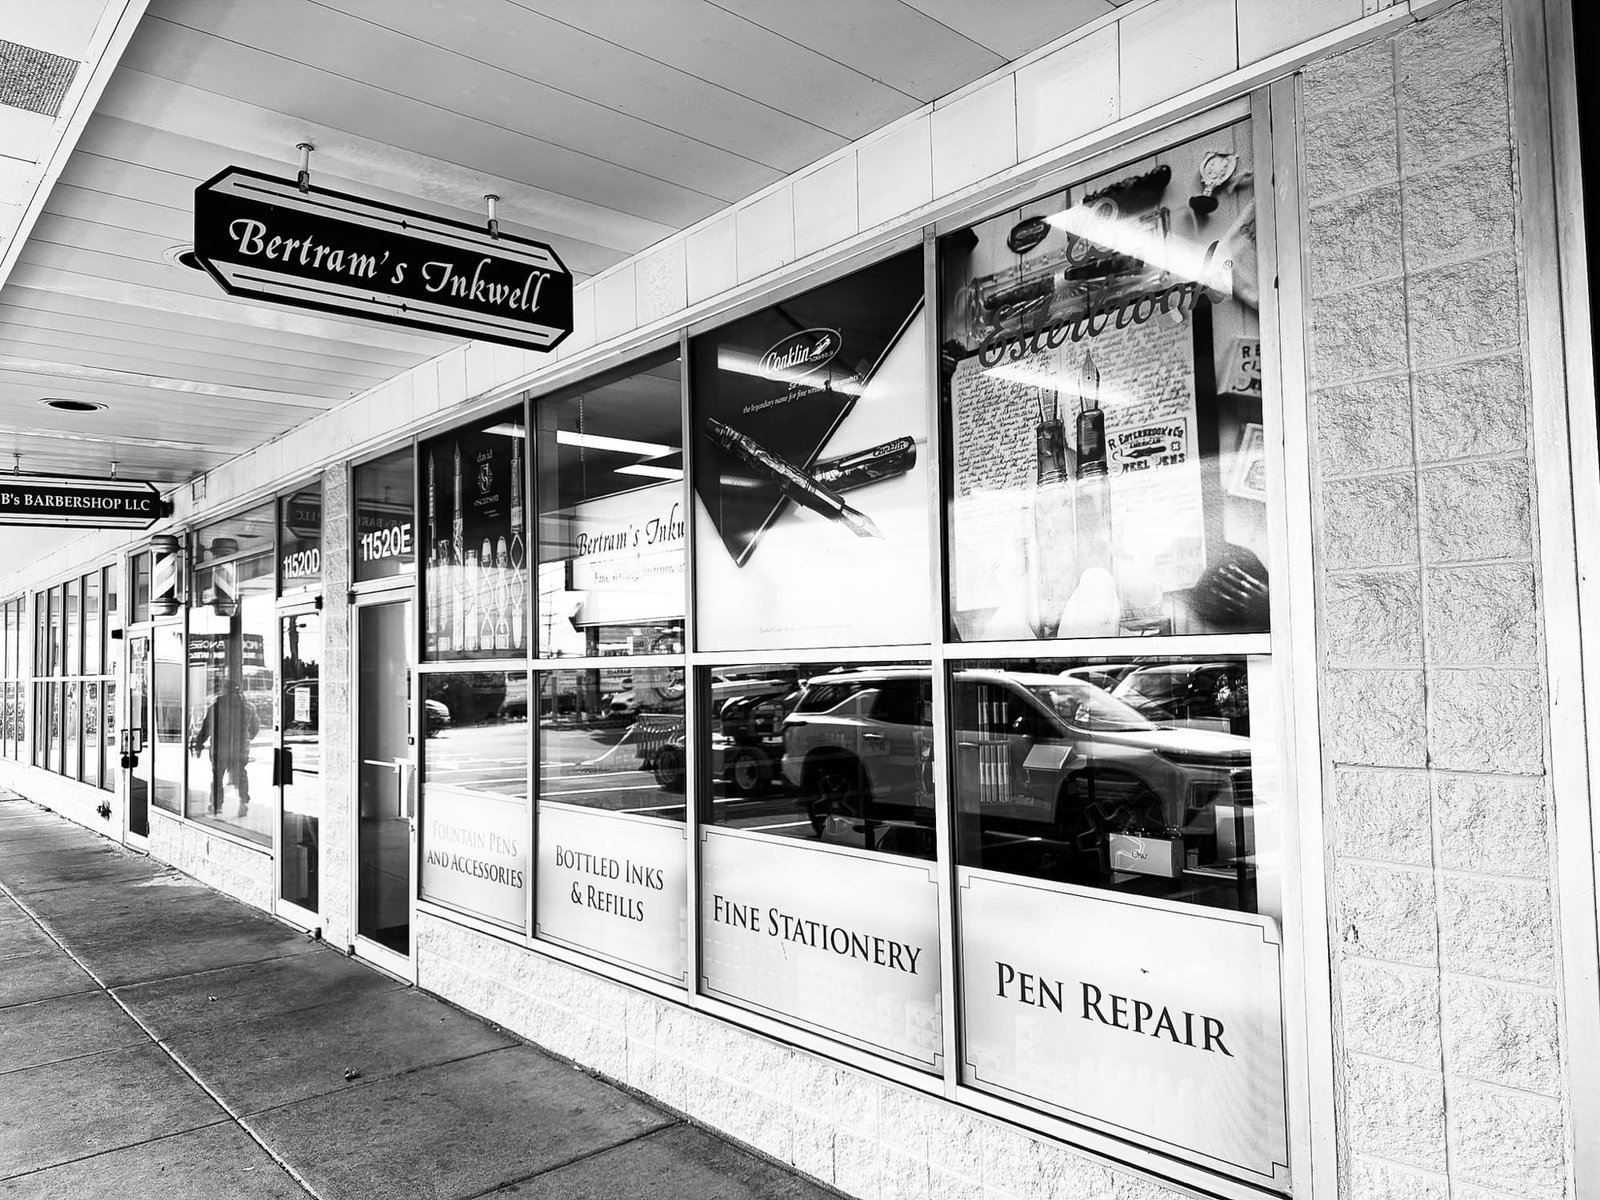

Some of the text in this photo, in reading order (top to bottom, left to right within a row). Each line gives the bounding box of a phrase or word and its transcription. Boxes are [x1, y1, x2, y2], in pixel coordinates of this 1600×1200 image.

[229, 218, 550, 312] Bertram's Inkwell
[766, 344, 810, 373] Conklin
[24, 494, 121, 510] BARBERSHOP
[125, 499, 150, 511] LLC
[361, 523, 412, 561] 11520E
[575, 524, 640, 557] Bertram's
[283, 548, 320, 579] 11520D
[489, 832, 517, 857] PENS
[427, 850, 523, 889] AND ACCESSORIES
[556, 845, 664, 891] BOTTLED INKS
[571, 881, 644, 922] & REFILLS
[713, 894, 923, 975] FINE STATIONERY
[995, 961, 1234, 1057] PEN REPAIR
